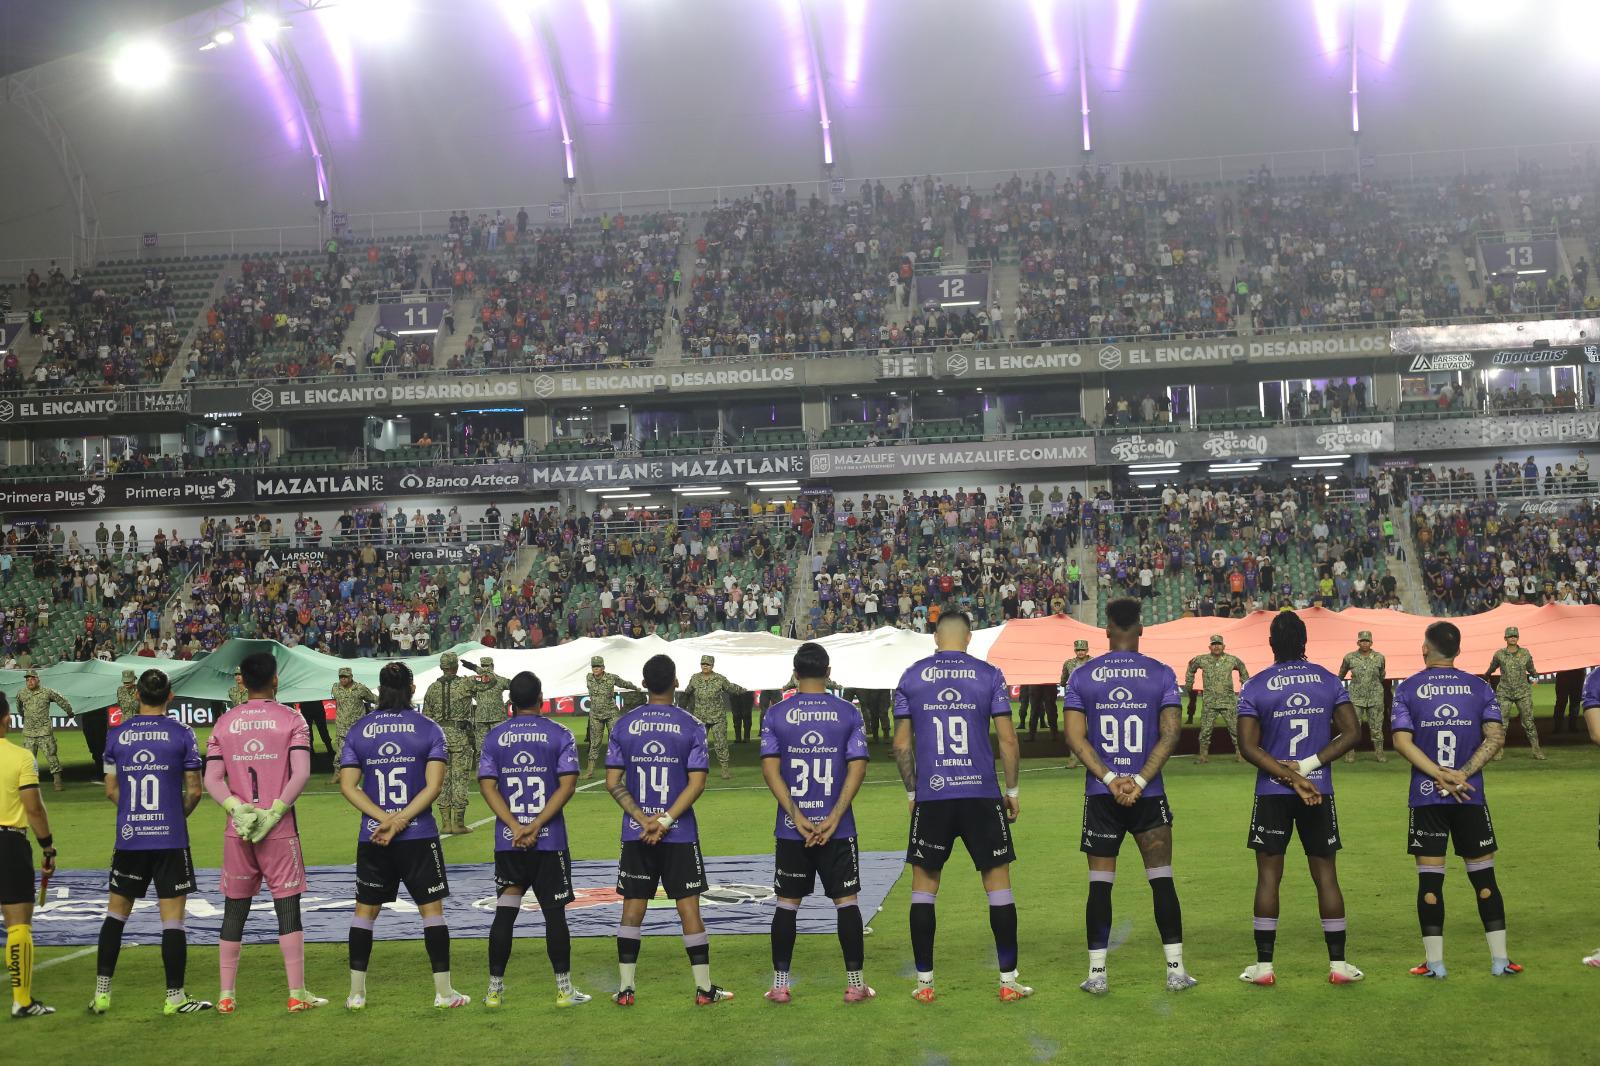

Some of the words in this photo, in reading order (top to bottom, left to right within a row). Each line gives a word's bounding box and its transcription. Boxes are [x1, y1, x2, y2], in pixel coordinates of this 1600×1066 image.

[1506, 246, 1532, 266] 13
[938, 278, 964, 298] 12
[404, 308, 427, 326] 11
[1128, 348, 1150, 364] EL
[1155, 343, 1244, 362] ENCANTO
[1250, 336, 1384, 358] DESARROLLOS
[1432, 354, 1472, 362] LARSSON
[974, 358, 996, 370] EL
[1000, 354, 1082, 370] ENCANTO
[561, 378, 581, 391] EL
[586, 374, 666, 390] ENCANTO
[671, 367, 794, 386] DESARROLLOS
[280, 391, 300, 405] EL
[304, 387, 387, 404] ENCANTO
[392, 381, 518, 400] DESARROLLOS
[20, 404, 38, 416] EL
[42, 400, 117, 414] ENCANTO
[834, 453, 896, 465] MAZALIFE
[900, 453, 936, 466] VIVE
[939, 445, 1088, 464] MAZALIFE.COM.MX
[426, 475, 470, 488] Banco
[472, 473, 519, 486] Azteca
[0, 491, 50, 503] Primera
[56, 491, 86, 502] Plus
[126, 486, 180, 499] Primera
[184, 484, 216, 496] Plus
[282, 552, 324, 561] LARSSON
[436, 550, 464, 559] Plus
[921, 666, 976, 682] Corona
[1092, 666, 1147, 683] Corona
[1266, 674, 1322, 690] Corona
[1417, 682, 1472, 700] Corona
[786, 708, 838, 726] Corona
[1274, 709, 1298, 718] Banco
[1298, 706, 1324, 715] Azteca
[229, 718, 276, 735] Corona
[363, 722, 416, 738] Corona
[628, 720, 681, 736] Corona
[1446, 718, 1472, 726] Azteca
[118, 730, 168, 746] Corona
[498, 730, 548, 747] Corona
[932, 716, 968, 754] 19
[1100, 714, 1143, 753] 90
[1289, 718, 1309, 757] 7
[1438, 730, 1457, 768] 8
[389, 755, 416, 763] Azteca
[1114, 757, 1130, 765] FABIO
[248, 766, 260, 803] 1
[374, 766, 408, 806] 15
[637, 766, 670, 804] 14
[790, 758, 834, 797] 34
[128, 774, 160, 812] 10
[507, 776, 546, 814] 23
[798, 800, 824, 808] MORENO
